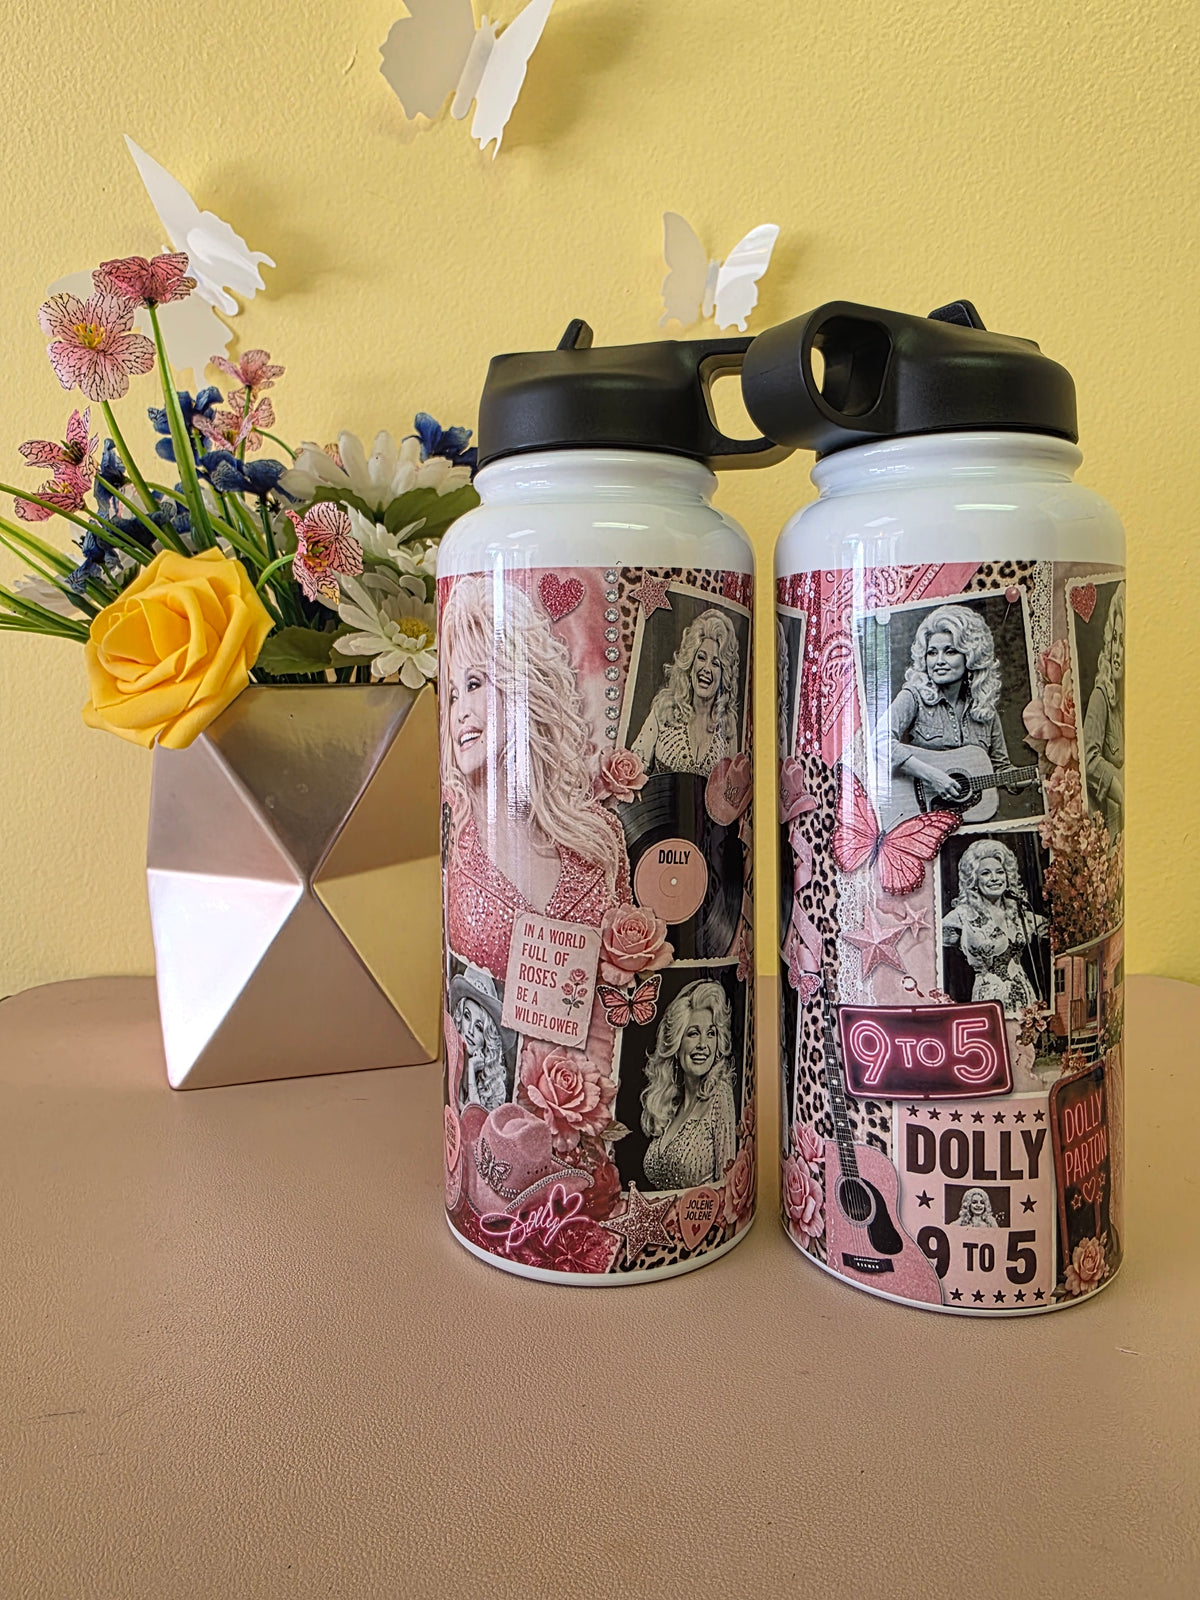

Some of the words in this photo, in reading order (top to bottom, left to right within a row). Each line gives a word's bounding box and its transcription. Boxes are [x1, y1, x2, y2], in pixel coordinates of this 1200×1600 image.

[658, 849, 691, 865] DOLLY
[523, 922, 536, 938] IN
[537, 926, 544, 941] A
[549, 928, 586, 950] WORLD
[521, 942, 548, 963] FULL
[554, 951, 570, 967] OF
[518, 962, 558, 989] ROSES
[516, 985, 529, 1003] BE
[531, 990, 538, 1006] A
[515, 1005, 579, 1037] WILDFLOWER
[849, 1020, 891, 1085] 9
[895, 1038, 946, 1068] TO
[952, 1017, 998, 1084] 5
[1064, 1087, 1103, 1144] DOLLY
[905, 1122, 1048, 1181] DOLLY
[1064, 1125, 1108, 1187] PARTON
[480, 1184, 589, 1253] Dolly
[683, 1210, 712, 1221] JOLENE
[685, 1199, 714, 1210] JOLENE
[916, 1225, 951, 1280] 9
[962, 1242, 996, 1273] TO
[1005, 1229, 1037, 1285] 5
